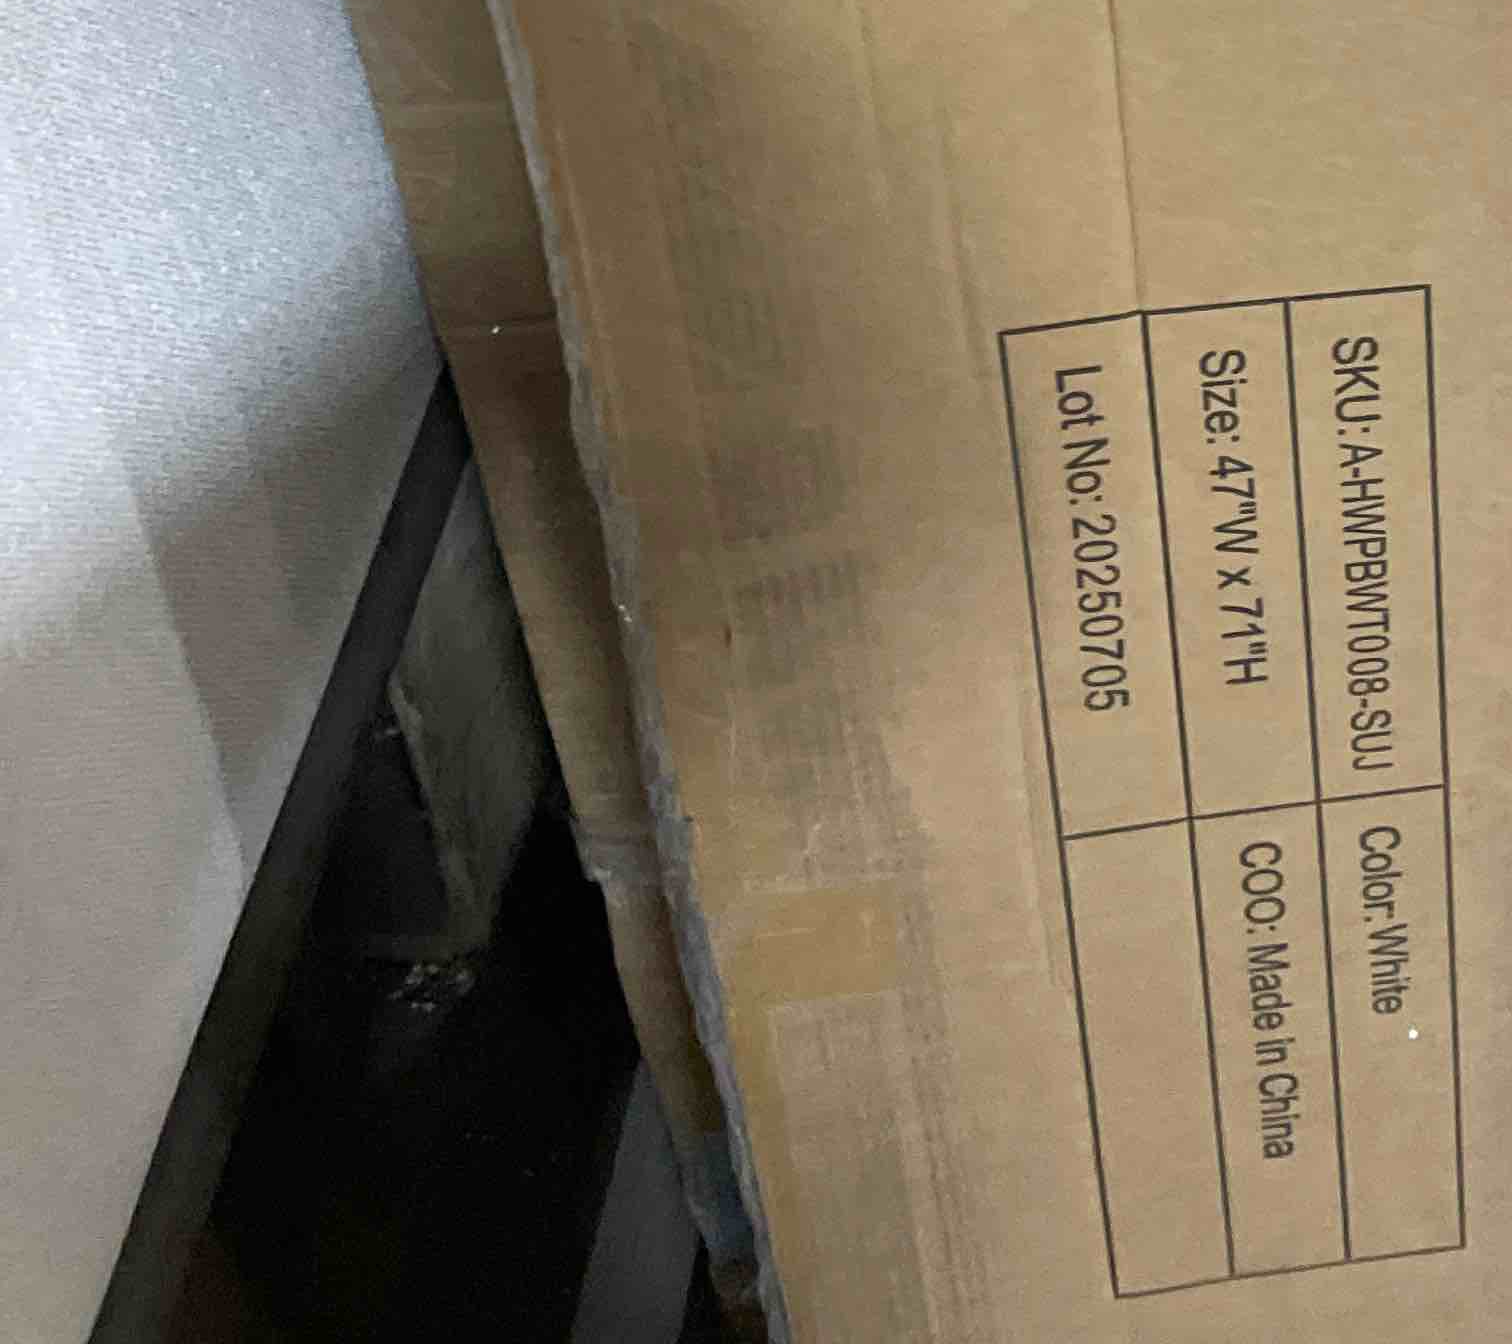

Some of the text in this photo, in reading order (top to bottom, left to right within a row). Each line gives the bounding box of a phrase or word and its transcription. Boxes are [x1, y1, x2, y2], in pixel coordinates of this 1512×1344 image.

[1054, 364, 1131, 713] Lot No: 20250705
[1198, 348, 1269, 687] Size: 47"W x 71"H
[1331, 335, 1394, 772] SKU: A-HWPBWT008-SUJ
[1238, 840, 1302, 1160] COO: Made in China
[1359, 824, 1410, 1015] Color: White
